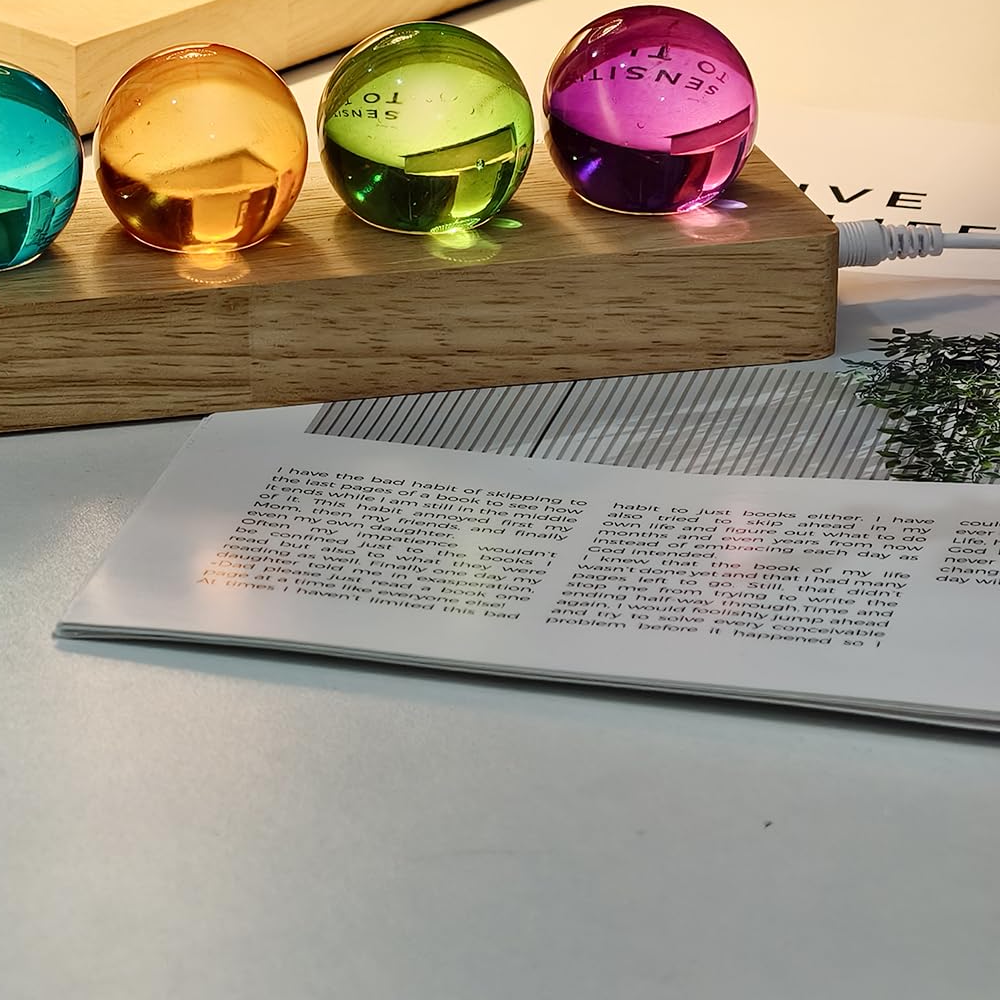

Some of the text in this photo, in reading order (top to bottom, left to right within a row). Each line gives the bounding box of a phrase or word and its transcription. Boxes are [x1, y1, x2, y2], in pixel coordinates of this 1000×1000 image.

[271, 475, 300, 484] the
[305, 478, 336, 488] last
[339, 483, 392, 494] pages
[435, 493, 480, 504] book
[486, 499, 504, 507] to
[544, 505, 583, 515] how
[288, 467, 329, 477] have
[335, 472, 364, 481] the
[370, 475, 406, 486] bad
[411, 480, 458, 493] habit
[486, 490, 563, 505] skipping
[281, 486, 323, 496] ends
[328, 491, 375, 501] while
[389, 499, 418, 507] am
[422, 502, 454, 511] still
[457, 505, 474, 513] in
[479, 508, 509, 516] the
[513, 512, 577, 523] middle
[313, 498, 346, 508] This
[356, 503, 403, 515] habit
[412, 511, 490, 524] annoyed
[501, 519, 534, 528] first
[544, 524, 573, 533] my
[612, 502, 660, 512] habit
[742, 510, 796, 518] books
[892, 516, 935, 524] have
[241, 518, 290, 529] Often
[309, 527, 338, 535] my
[356, 531, 458, 547] impatience
[247, 510, 288, 520] even
[293, 515, 322, 524] my
[326, 519, 364, 529] own
[312, 508, 352, 518] then
[361, 514, 390, 523] my
[470, 526, 506, 535] and
[514, 529, 568, 541] finally
[602, 520, 641, 528] own
[649, 522, 675, 530] life
[822, 531, 870, 539] what
[607, 511, 643, 519] also
[657, 515, 700, 523] tried
[746, 519, 783, 527] skip
[797, 521, 856, 530] ahead
[902, 527, 932, 535] my
[235, 526, 258, 534] be
[270, 531, 349, 545] confined
[357, 540, 392, 550] just
[479, 554, 533, 565] books
[587, 545, 626, 554] God
[592, 536, 660, 547] instead
[693, 543, 794, 554] embracing
[803, 548, 848, 556] each
[857, 550, 891, 560] day
[597, 529, 668, 538] months
[829, 539, 873, 548] from
[229, 535, 269, 545] read
[279, 540, 310, 549] but
[320, 546, 356, 555] also
[395, 555, 440, 565] what
[452, 561, 492, 571] they
[502, 566, 546, 574] were
[599, 555, 650, 565] knew
[661, 559, 697, 567] that
[753, 563, 800, 572] book
[811, 566, 832, 574] of
[842, 569, 872, 578] my
[936, 575, 970, 584] day
[551, 608, 588, 616] and
[597, 611, 621, 619] try
[713, 619, 764, 629] every
[772, 624, 885, 637] conceivable
